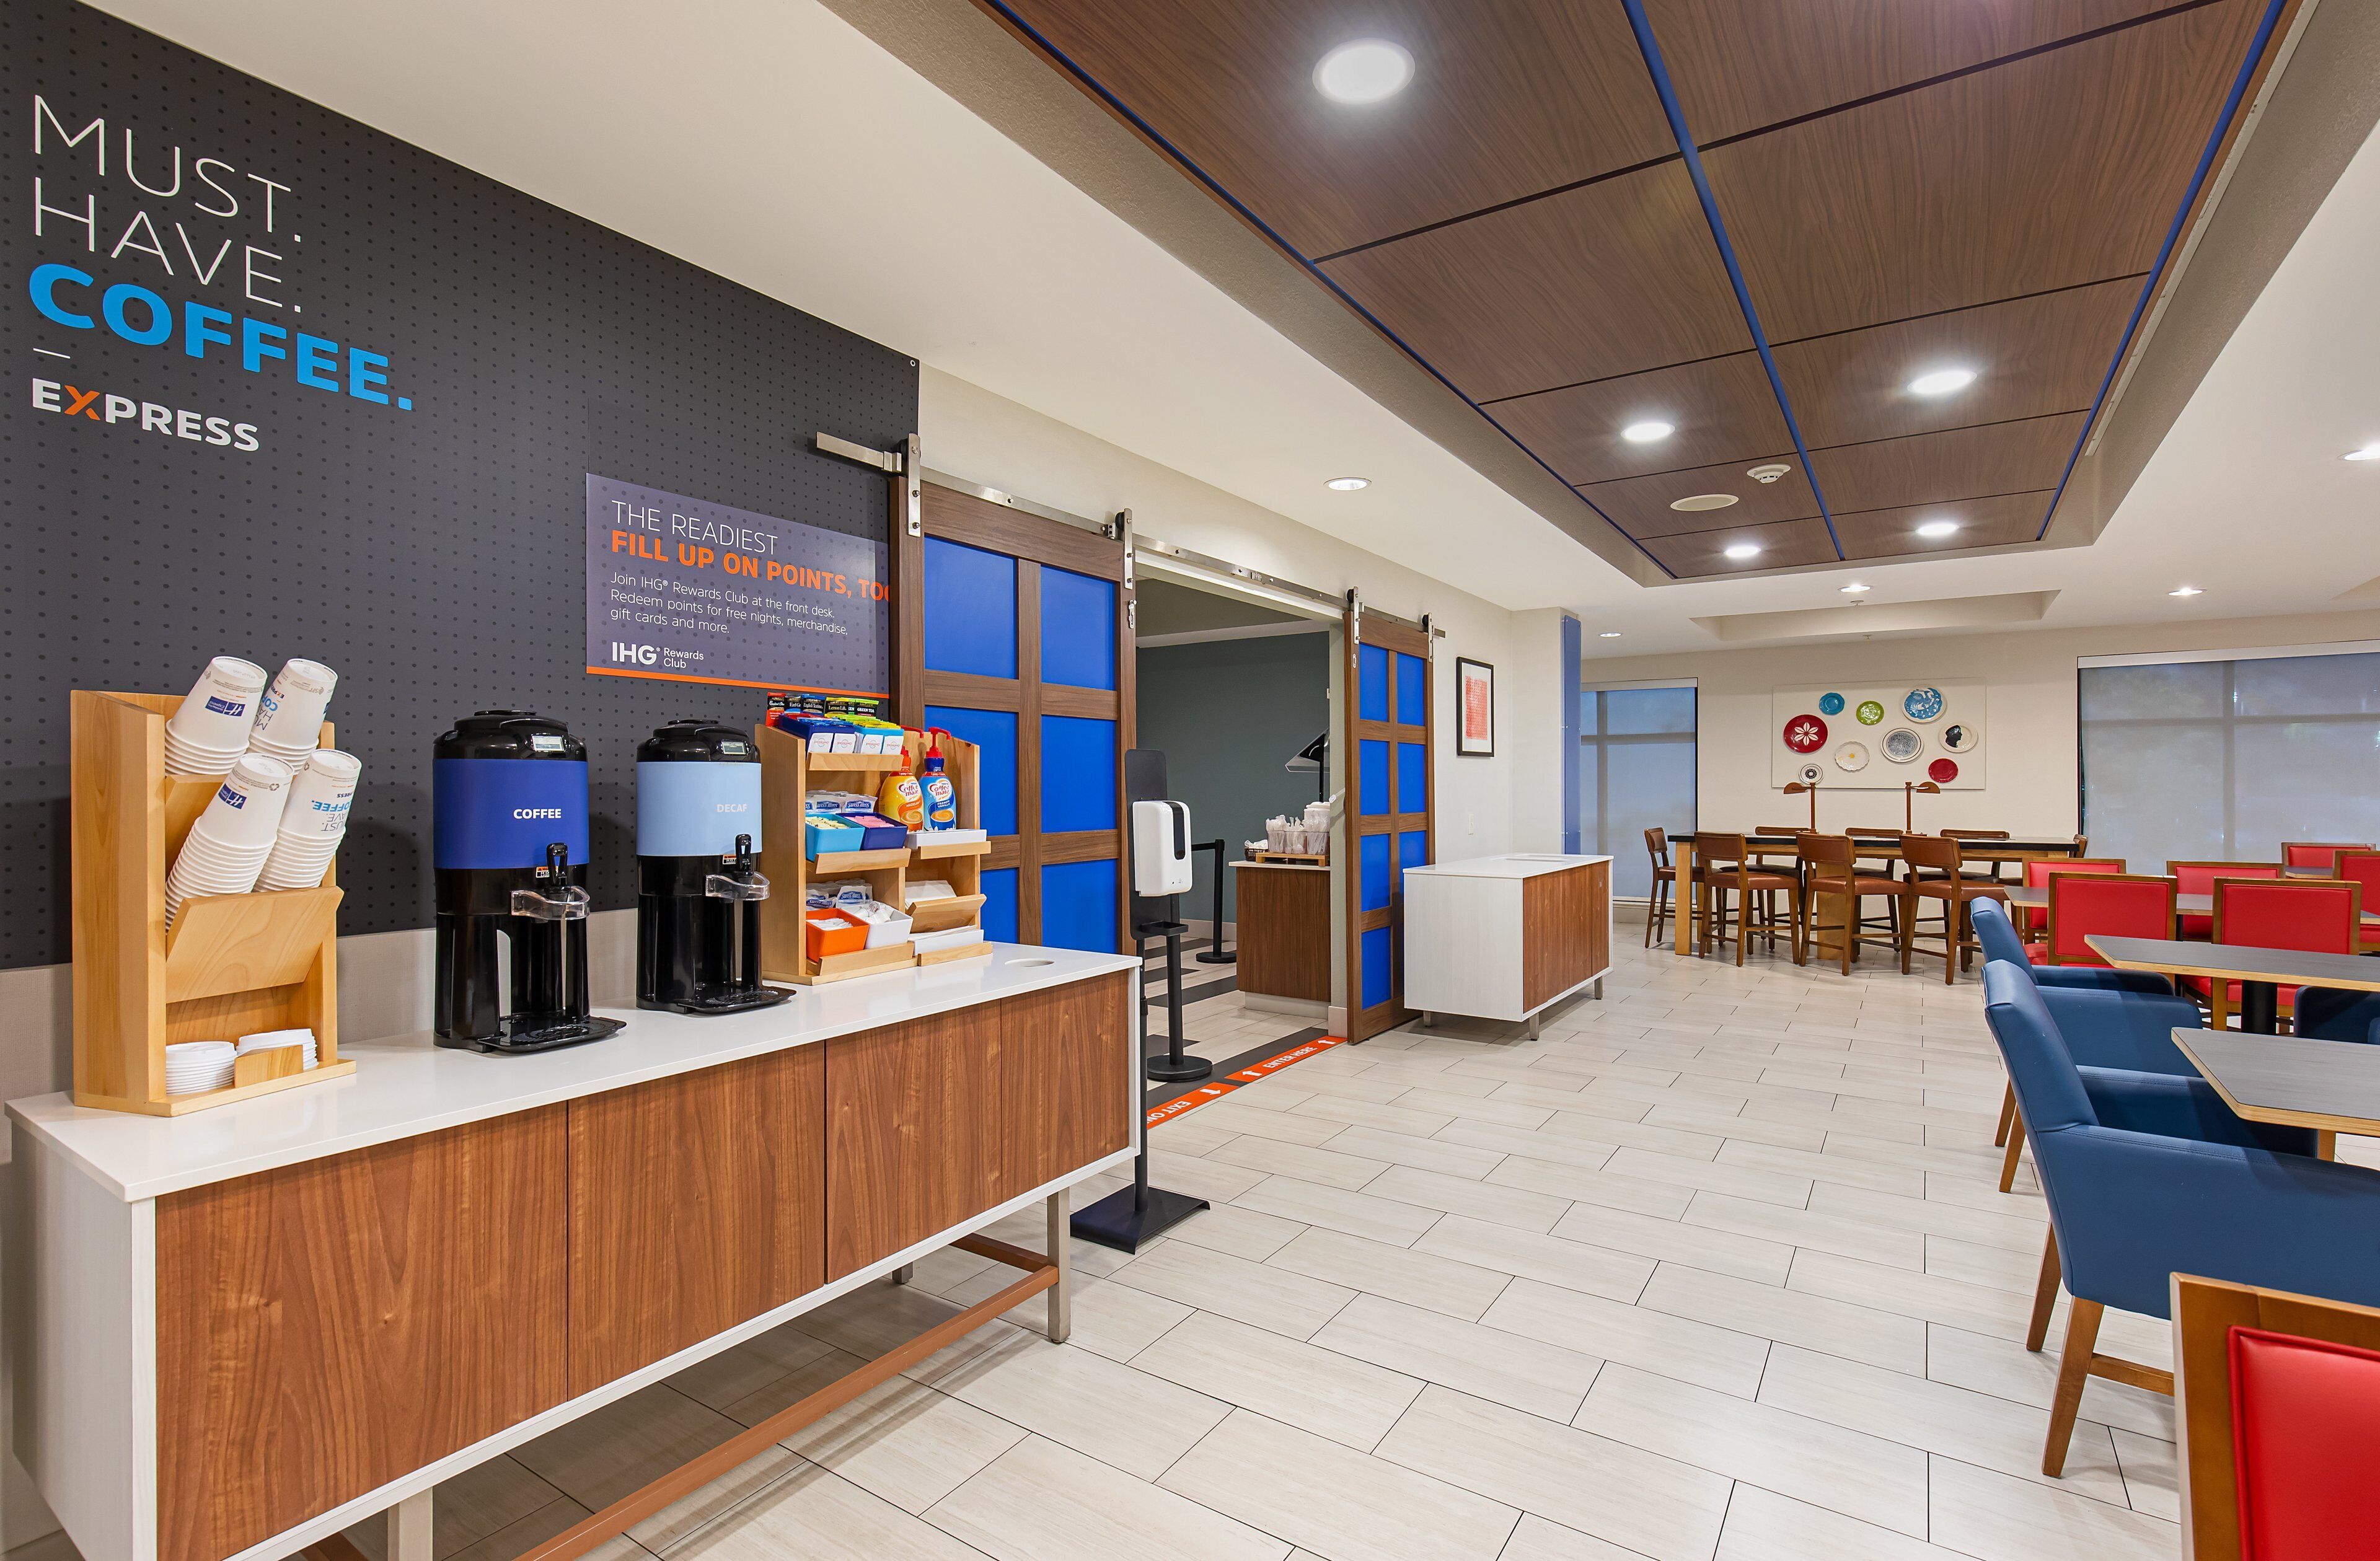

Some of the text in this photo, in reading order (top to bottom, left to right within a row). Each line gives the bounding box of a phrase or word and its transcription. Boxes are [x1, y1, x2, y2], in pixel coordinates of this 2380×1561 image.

[35, 95, 301, 243] MUST.
[35, 177, 301, 313] HAVE.
[29, 263, 412, 410] COFFEE.
[33, 378, 259, 452] EXPRESS
[612, 499, 778, 555] THE READIEST
[612, 530, 669, 562] FILL
[679, 543, 714, 568] UP
[723, 553, 758, 578] ON
[767, 560, 852, 598] POINTS,
[610, 572, 636, 586] Join
[673, 581, 721, 600] Rewards
[725, 591, 749, 604] Club
[752, 596, 762, 607] at
[765, 597, 782, 610] the
[785, 600, 808, 614] front
[811, 605, 835, 618] desk.
[610, 589, 848, 635] Redeem points for free nights, merchandise,
[610, 607, 729, 633] gift cards and more.
[663, 647, 704, 661] Rewards
[663, 657, 687, 669] Club
[311, 800, 351, 812] OFFEE.
[326, 812, 346, 822] AVE.
[513, 808, 562, 819] COFFEE
[716, 804, 747, 812] DECAF
[320, 820, 344, 832] UST.
[1263, 1046, 1318, 1068] ENTER HERE
[1147, 1101, 1192, 1124] EXIT ON
